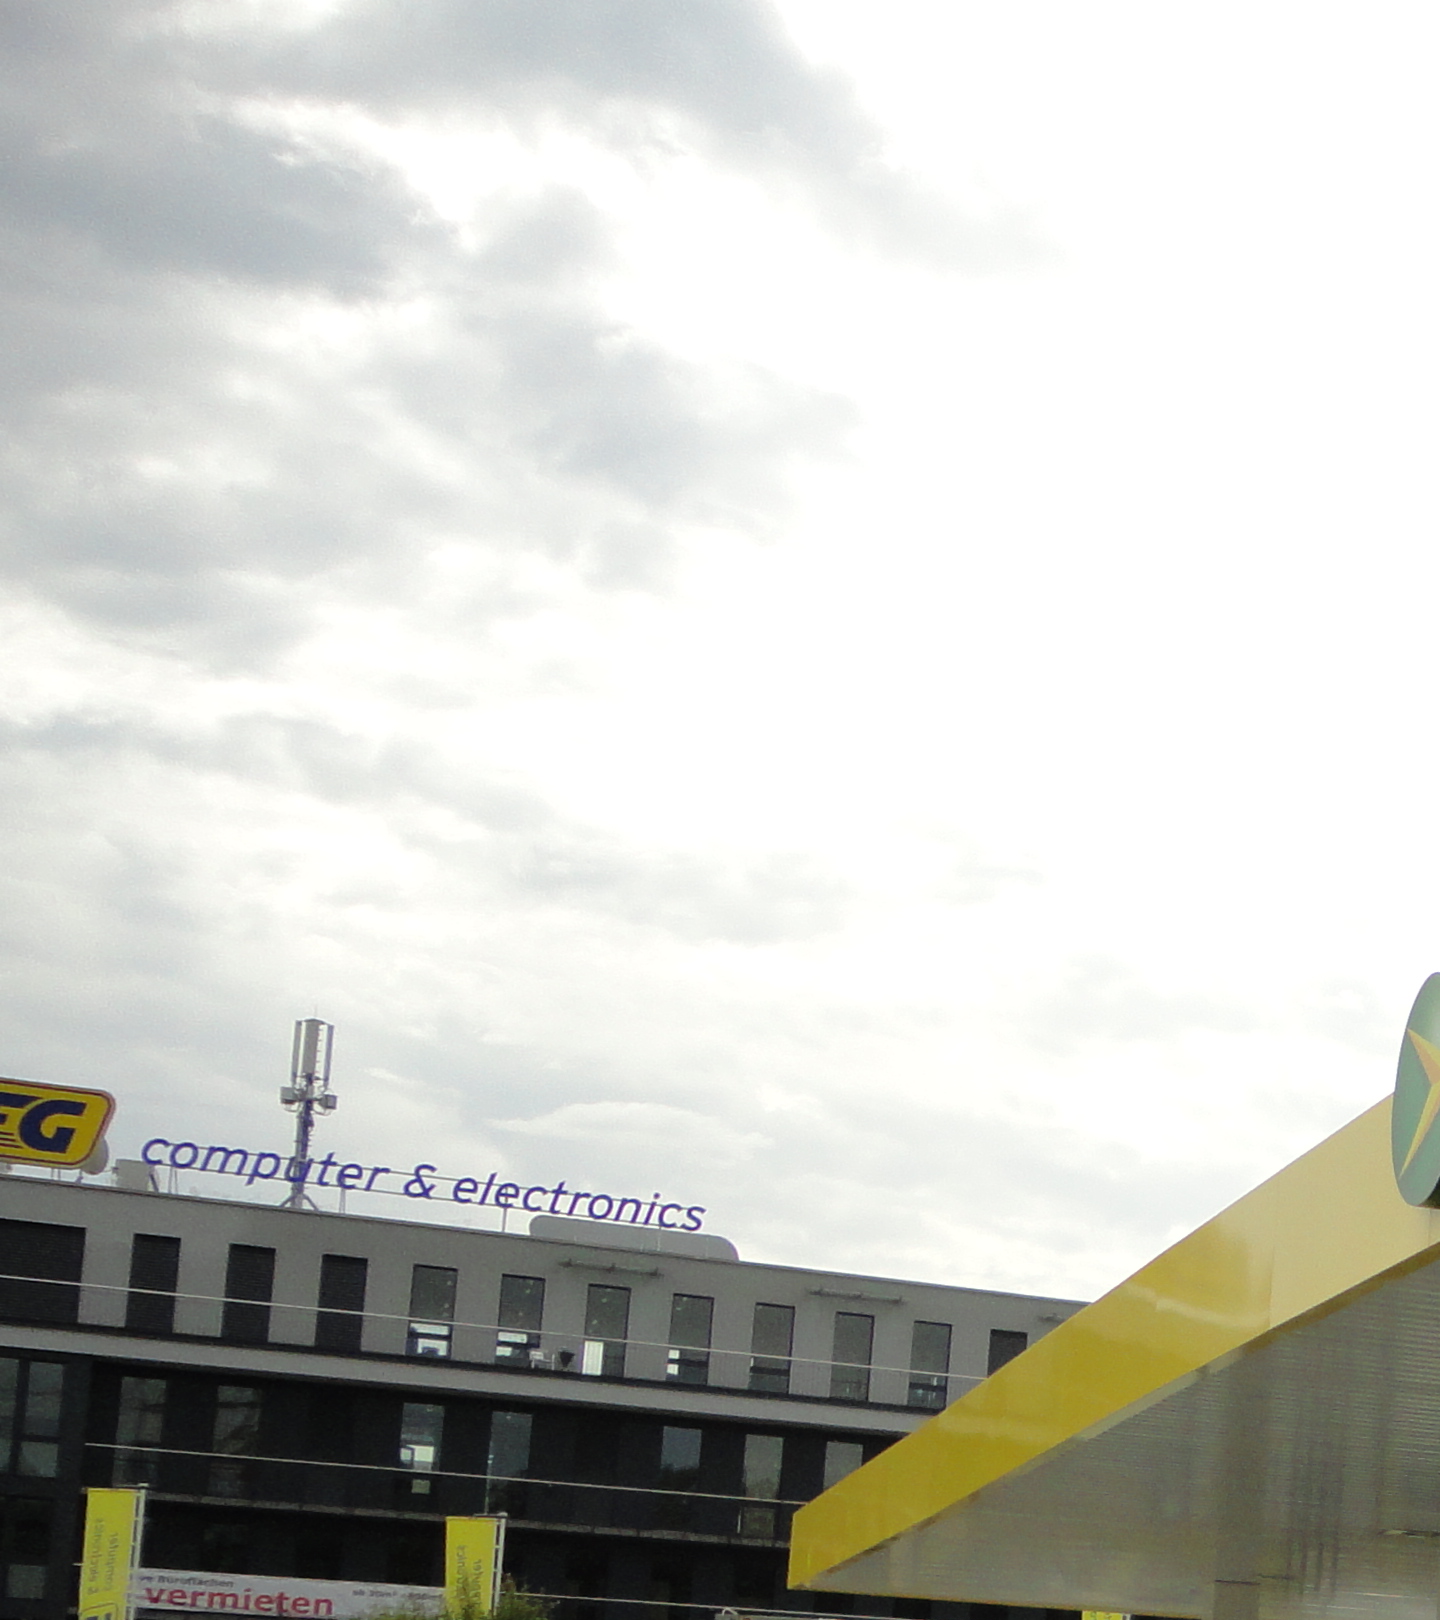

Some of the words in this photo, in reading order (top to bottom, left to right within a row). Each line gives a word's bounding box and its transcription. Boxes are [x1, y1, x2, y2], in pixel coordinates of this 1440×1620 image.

[141, 1138, 391, 1191] computer
[403, 1163, 438, 1200] &
[452, 1172, 707, 1232] electronics
[144, 1586, 334, 1616] vermieten
